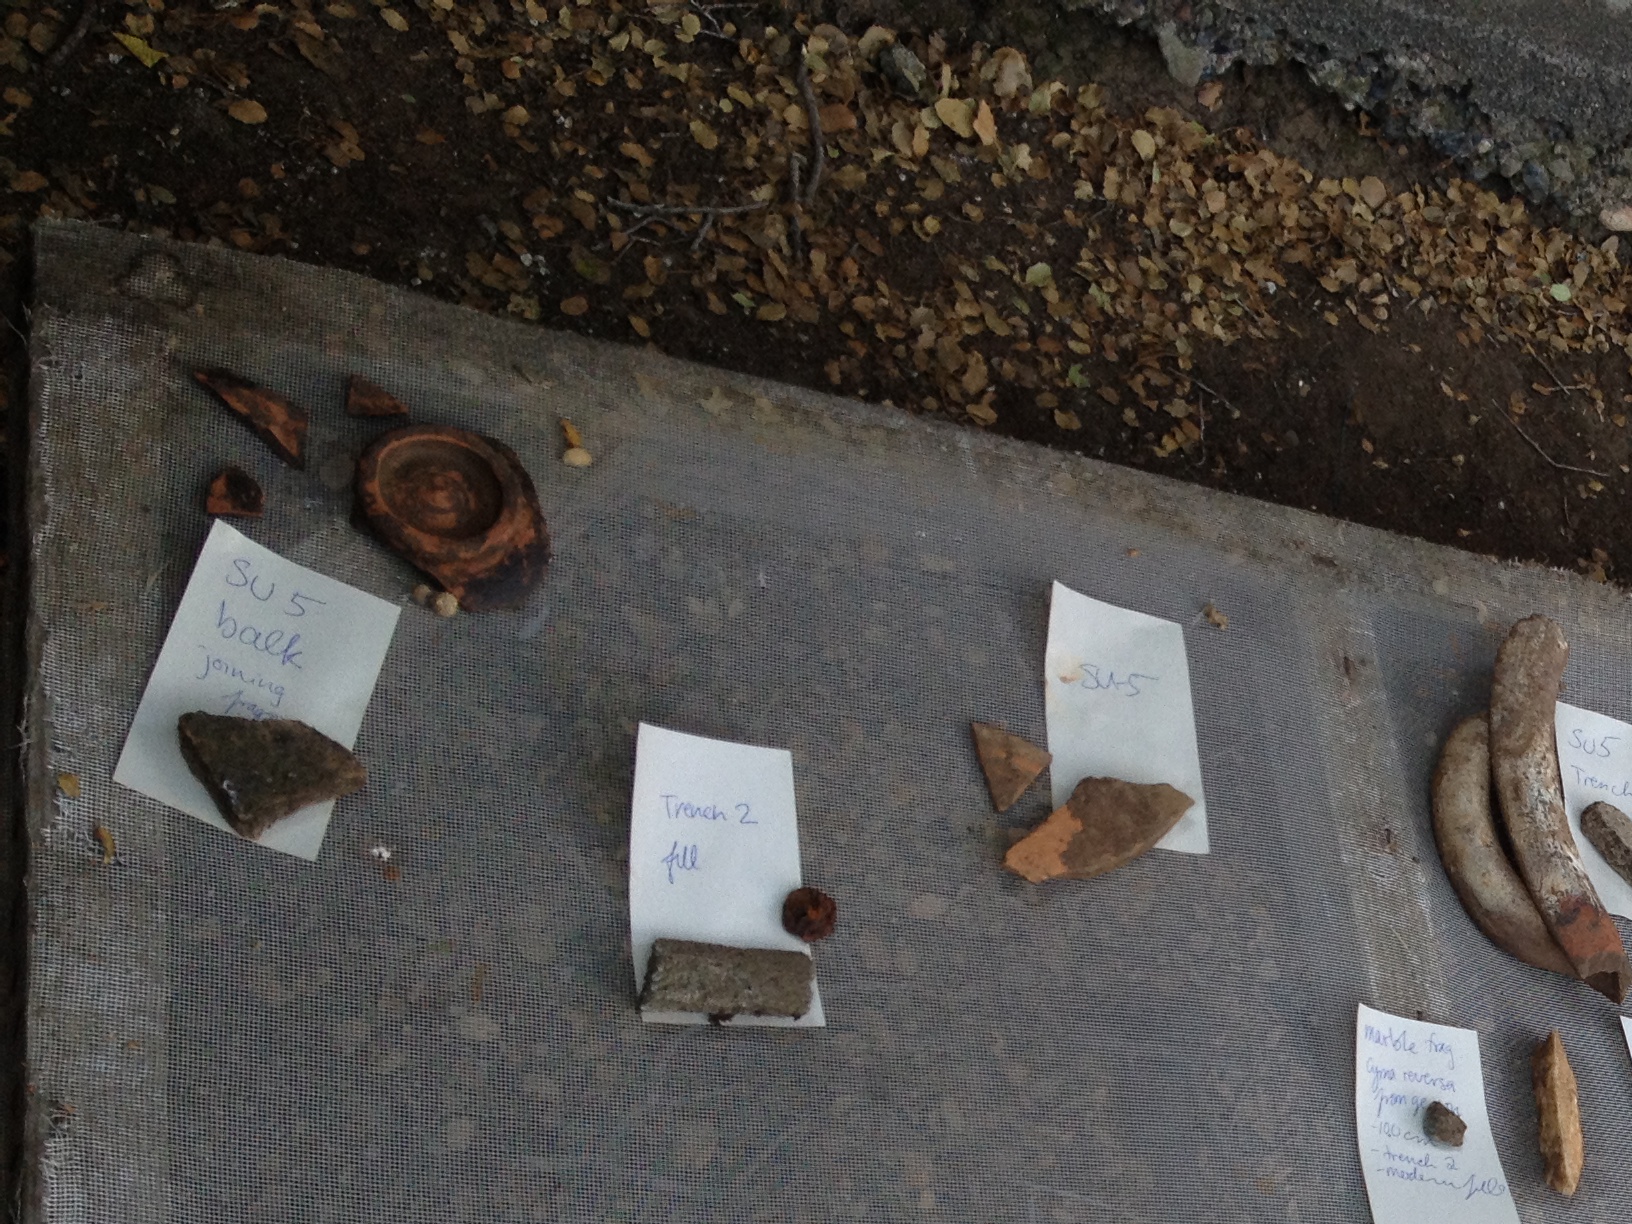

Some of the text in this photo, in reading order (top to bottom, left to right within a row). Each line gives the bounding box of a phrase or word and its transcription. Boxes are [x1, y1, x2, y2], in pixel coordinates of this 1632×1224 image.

[226, 559, 327, 617] SU 5
[660, 794, 759, 824] Trench 2
[661, 841, 699, 884] fill
[1445, 1156, 1458, 1170] 2
